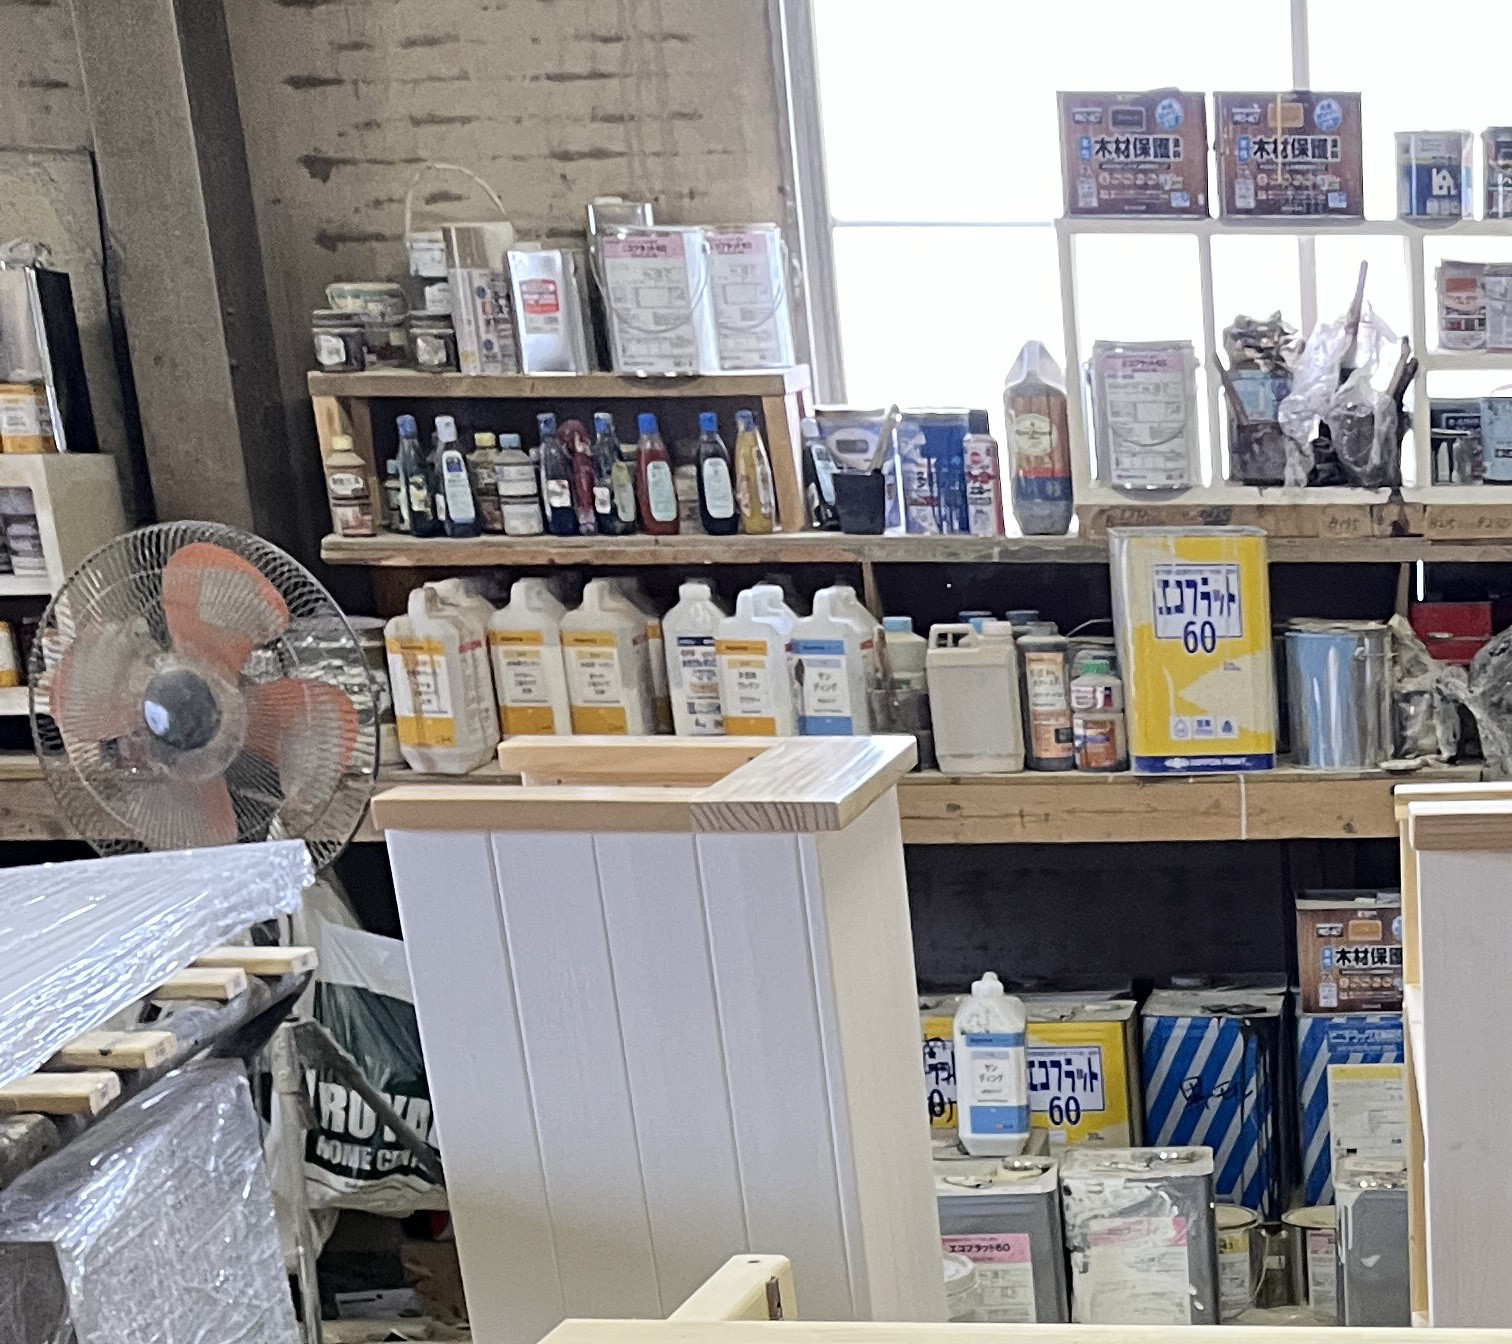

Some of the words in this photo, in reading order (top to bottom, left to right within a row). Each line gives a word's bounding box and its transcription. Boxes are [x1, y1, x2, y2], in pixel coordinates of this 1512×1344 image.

[1183, 620, 1216, 654] 60
[318, 1081, 434, 1143] ROYA
[1048, 1095, 1081, 1126] 60
[315, 1135, 372, 1170] HOME
